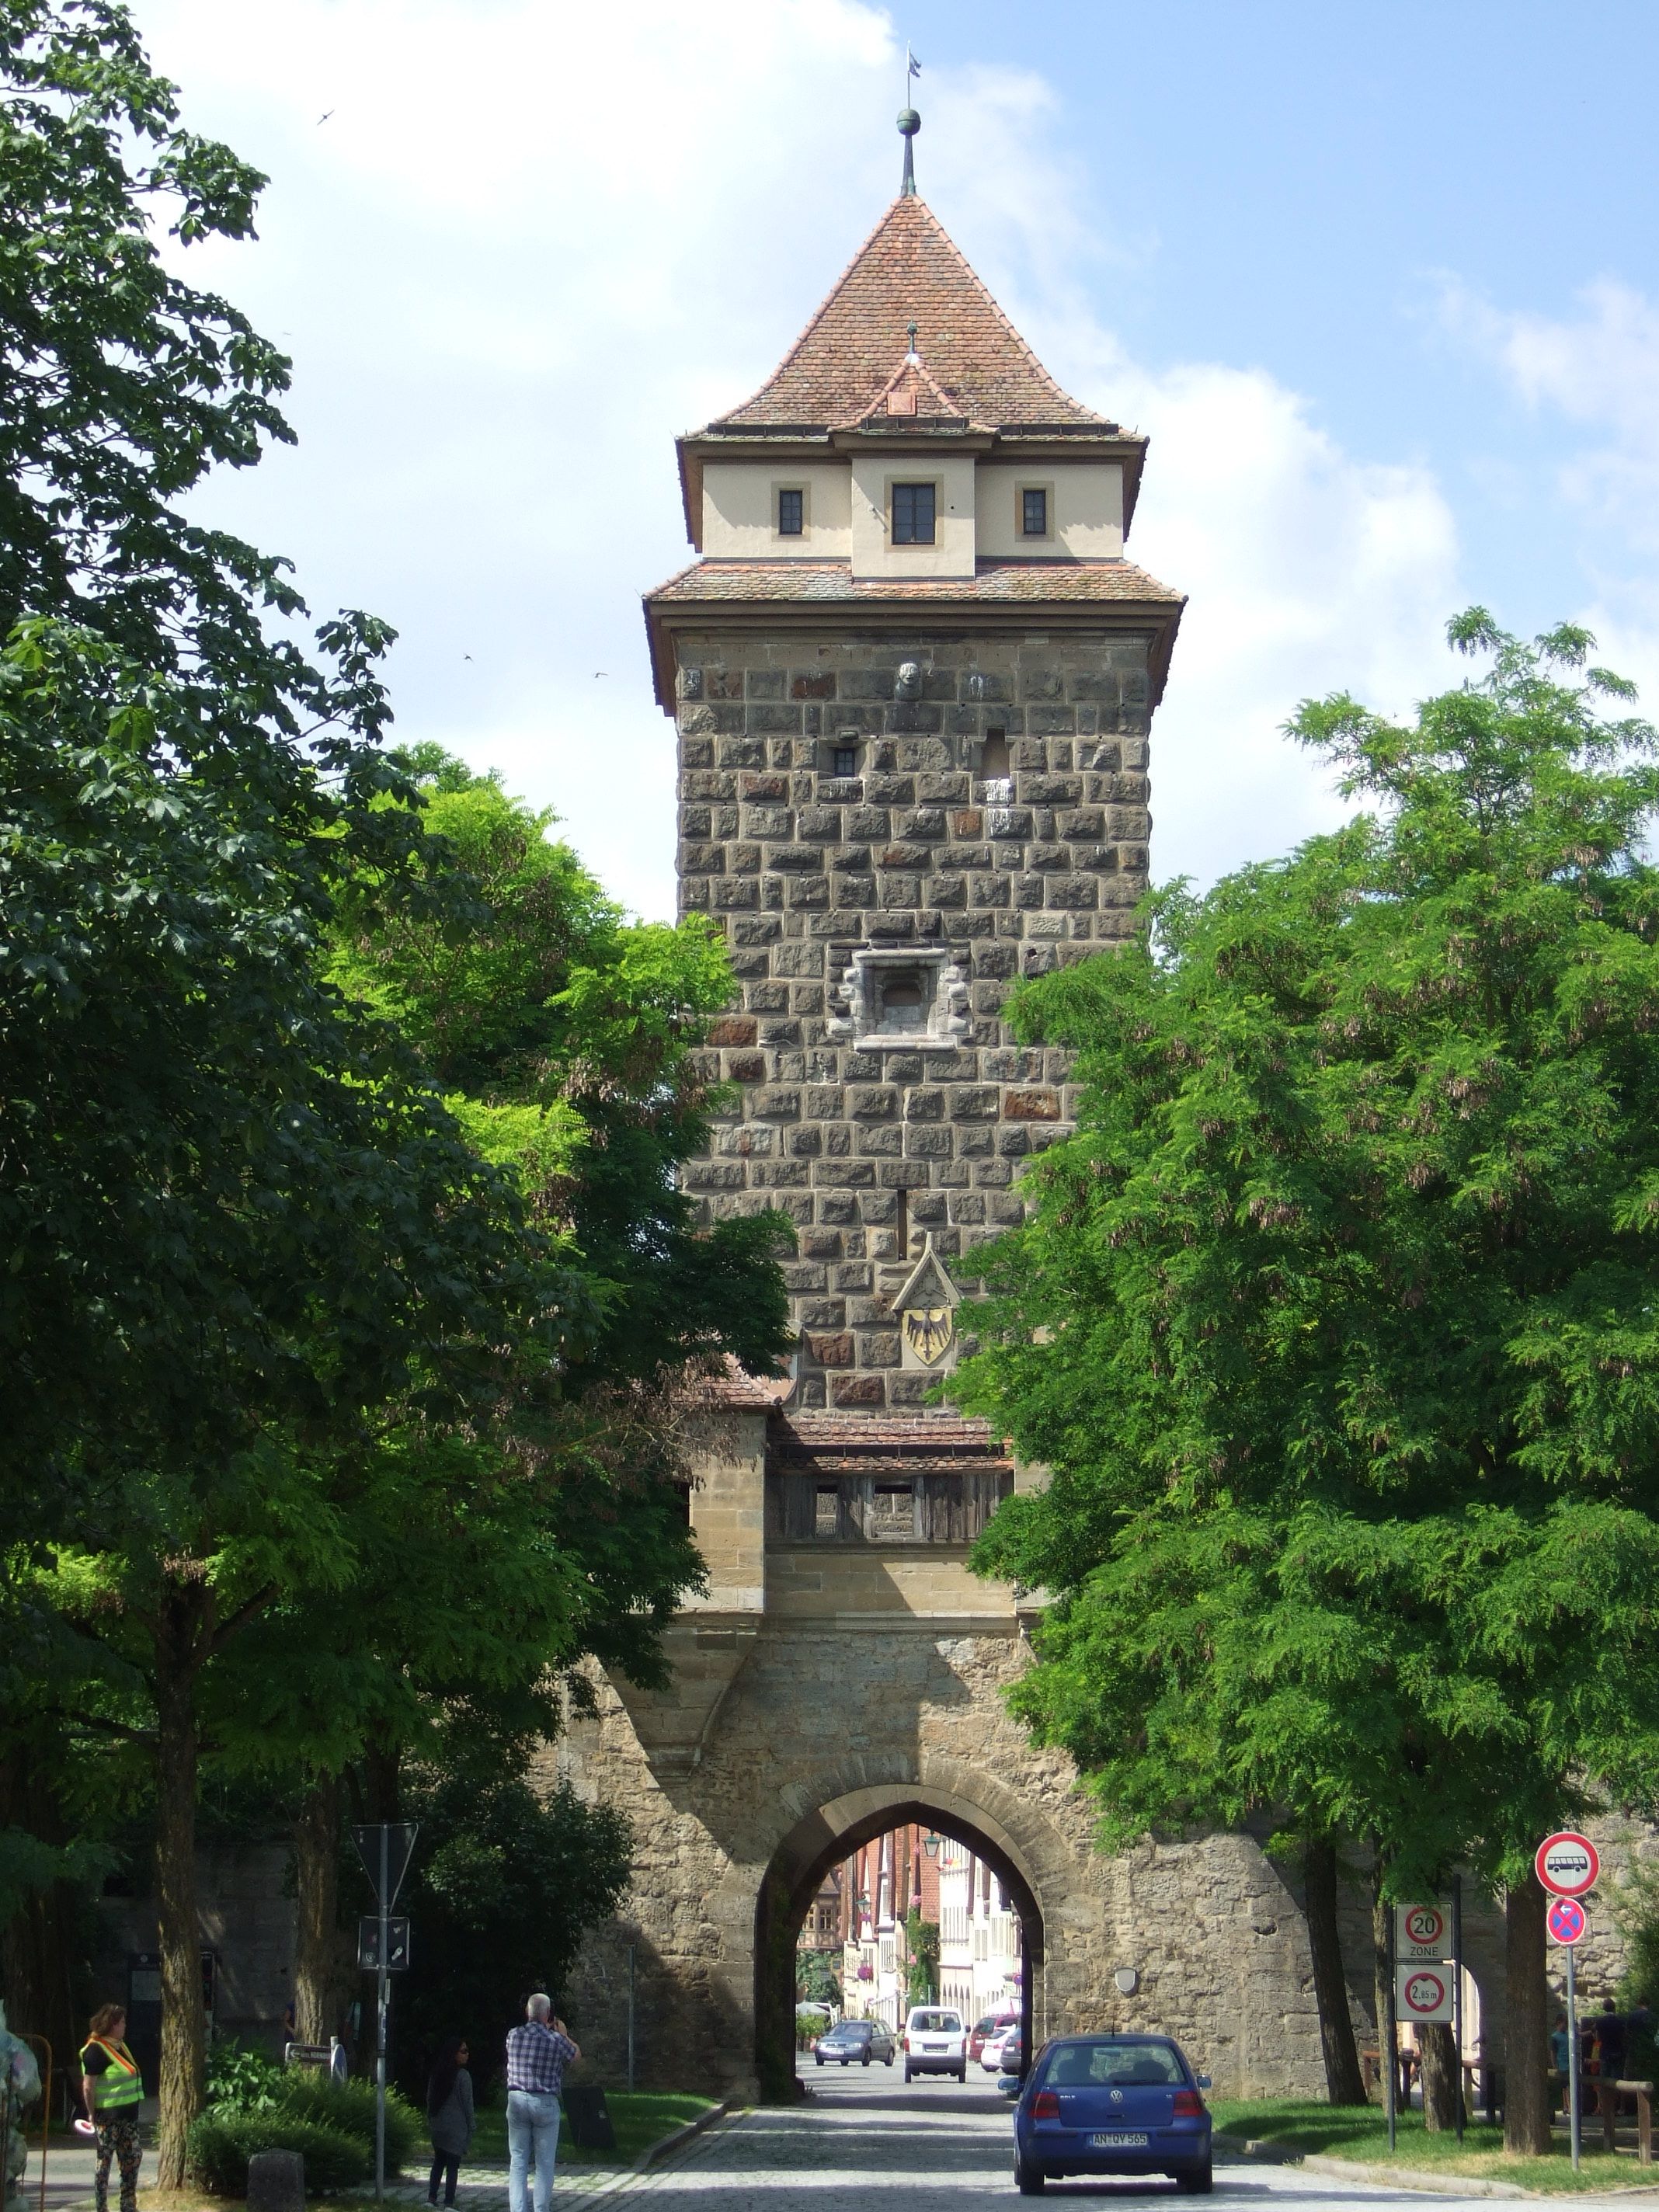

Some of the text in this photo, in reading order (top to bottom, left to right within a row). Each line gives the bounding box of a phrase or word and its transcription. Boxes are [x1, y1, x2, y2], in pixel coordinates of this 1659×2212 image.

[1414, 1917, 1435, 1934] 20
[1410, 1947, 1438, 1956] ZONE
[1094, 2134, 1107, 2144] AN
[1129, 2134, 1146, 2144] 565
